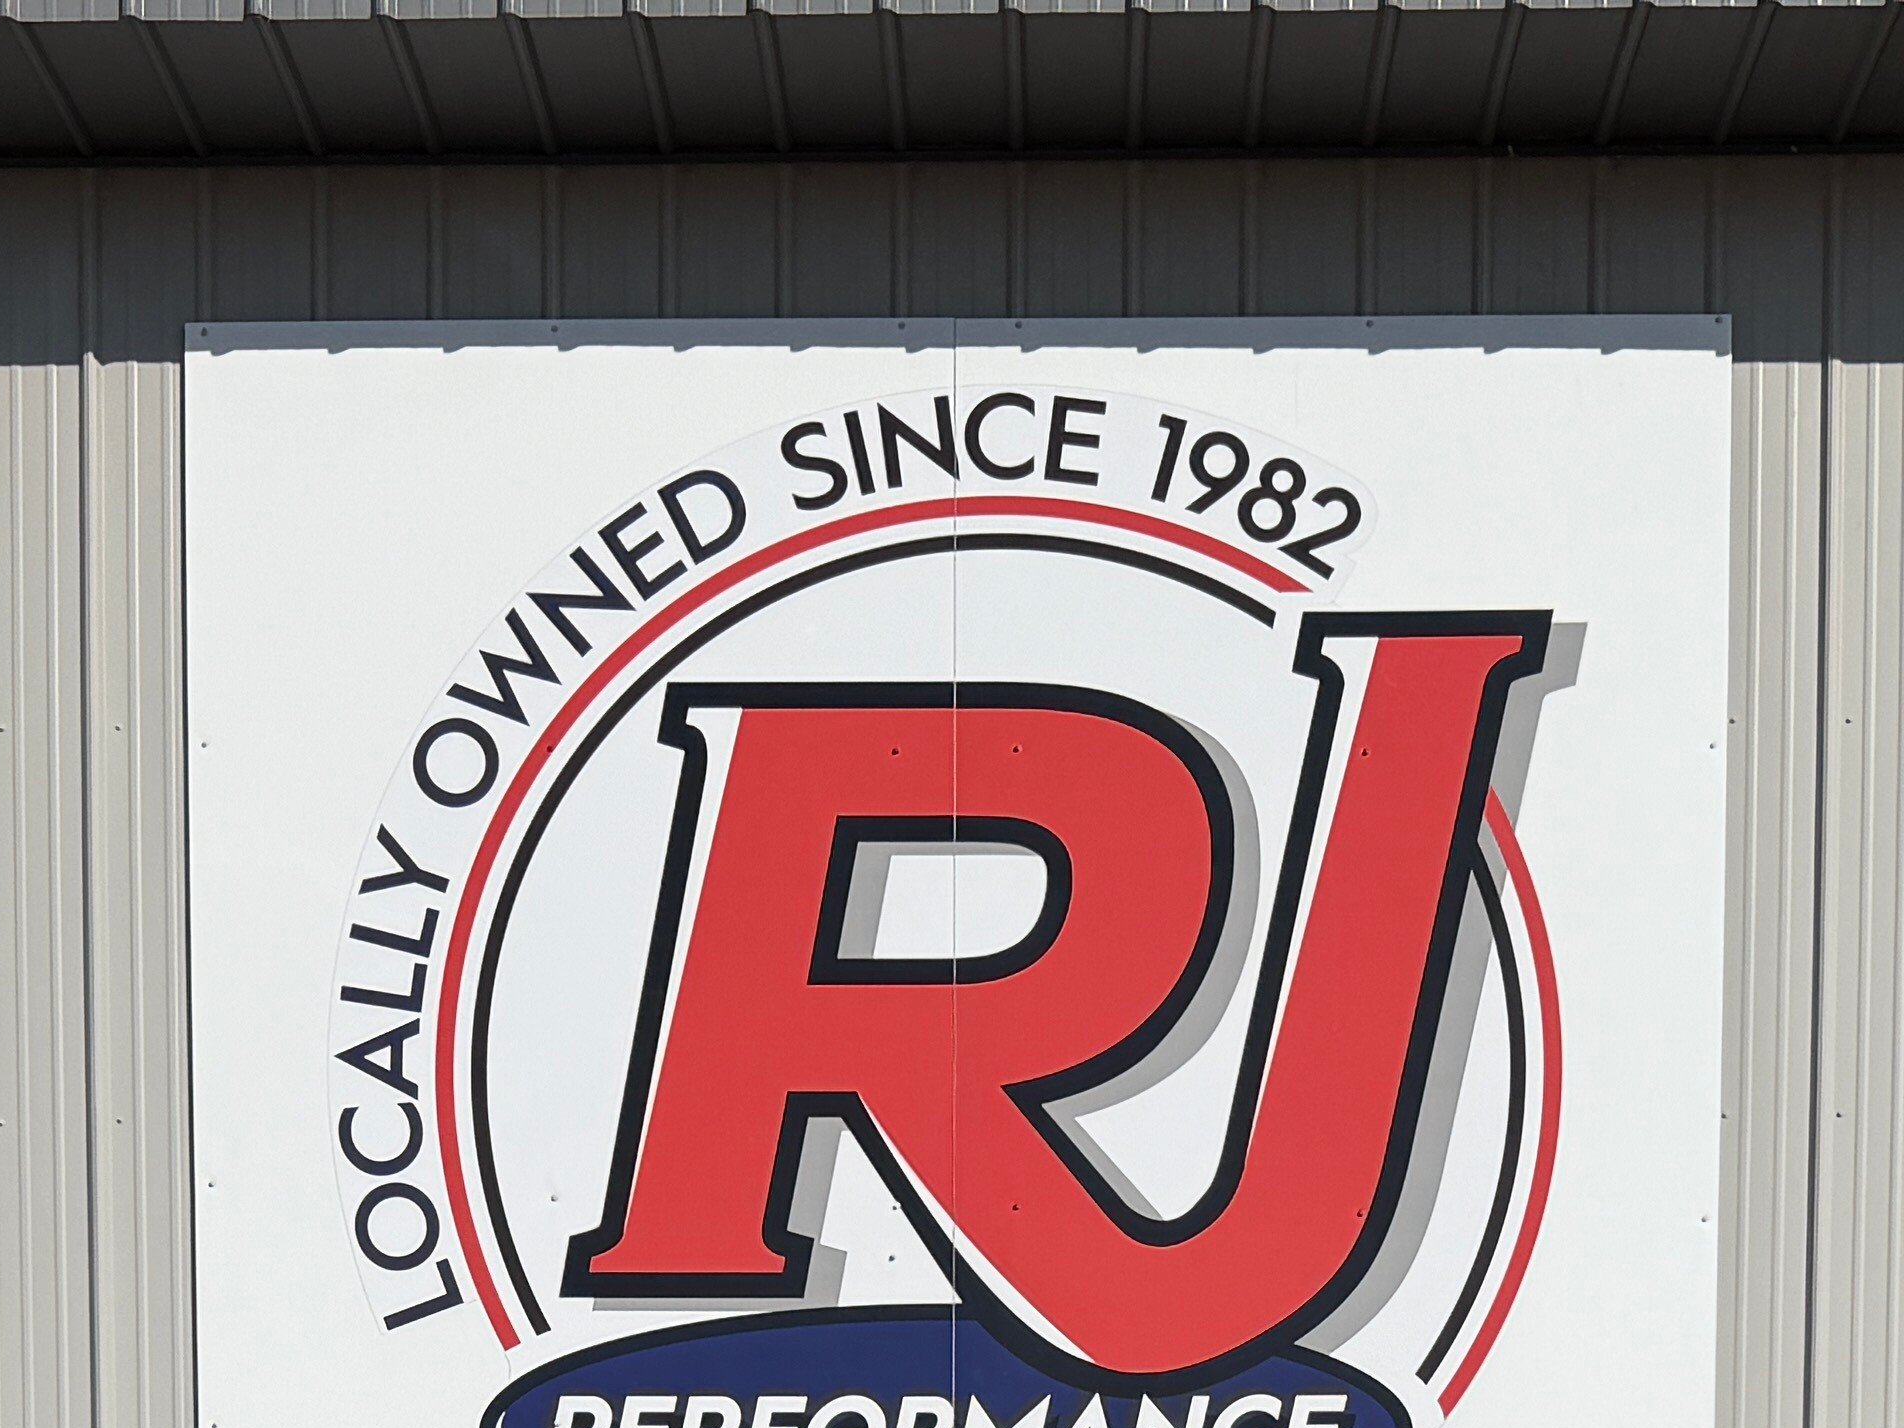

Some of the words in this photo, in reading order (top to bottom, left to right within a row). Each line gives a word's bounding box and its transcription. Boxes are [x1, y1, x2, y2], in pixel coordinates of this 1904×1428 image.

[335, 824, 464, 1330] LOCALLY
[413, 470, 746, 807] OWNED
[781, 393, 1106, 510] SINCE
[1152, 414, 1361, 580] 1982
[561, 609, 1553, 1390] RJ
